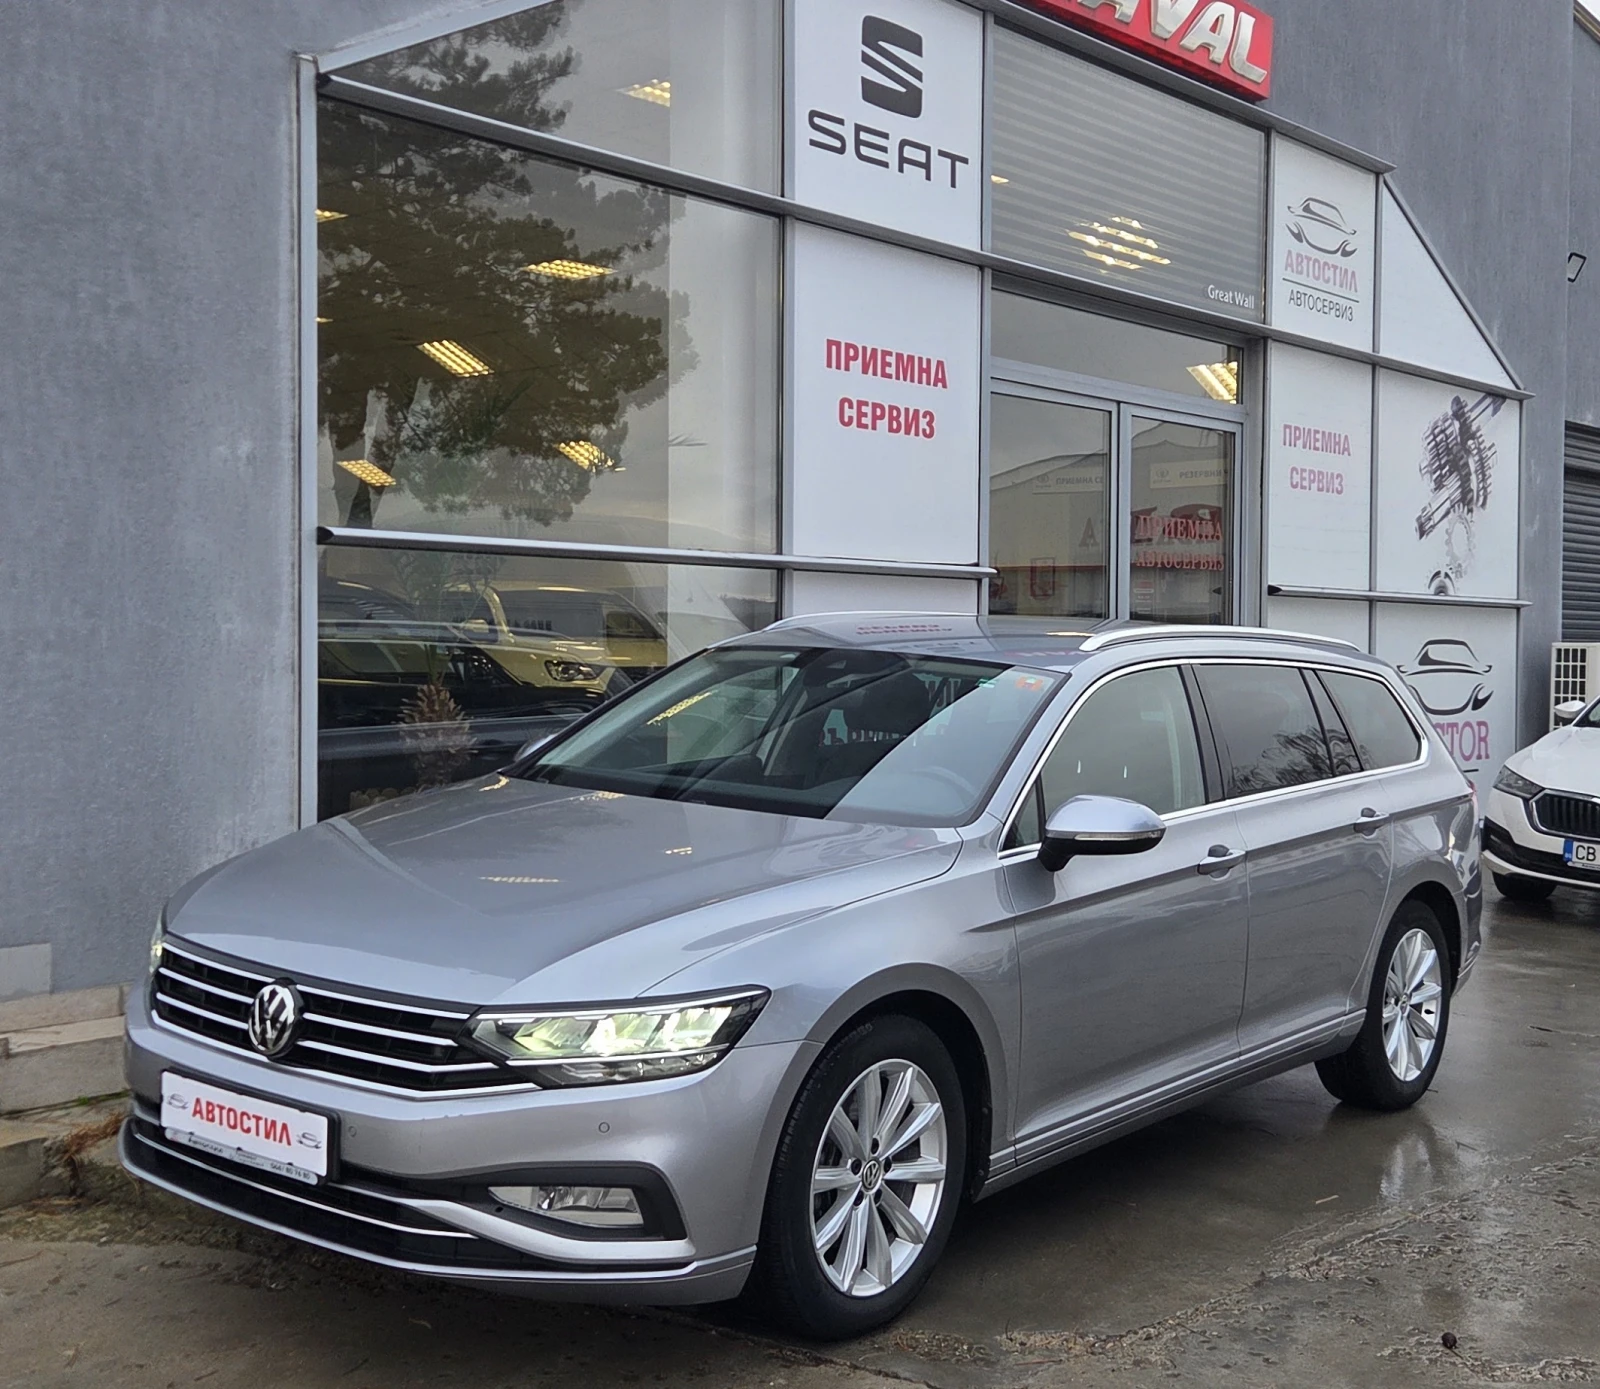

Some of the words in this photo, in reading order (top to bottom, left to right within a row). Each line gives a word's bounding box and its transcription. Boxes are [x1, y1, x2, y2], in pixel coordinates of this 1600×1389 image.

[807, 109, 970, 189] SEAT
[1284, 248, 1358, 293] АВТОСТИЛ
[1207, 284, 1233, 303] Great
[1234, 291, 1255, 309] Wall
[1288, 289, 1354, 322] АВТОСЕРВИЗ
[826, 338, 948, 389] ПРИЕМНА
[838, 396, 936, 439] СЕРВИЗ
[1282, 423, 1352, 457] ПРИЕМНА
[1289, 466, 1344, 495] СЕРВИЗ
[1134, 514, 1223, 542] ПРИЕМНА
[191, 1097, 292, 1147] АВТОСТИЛ
